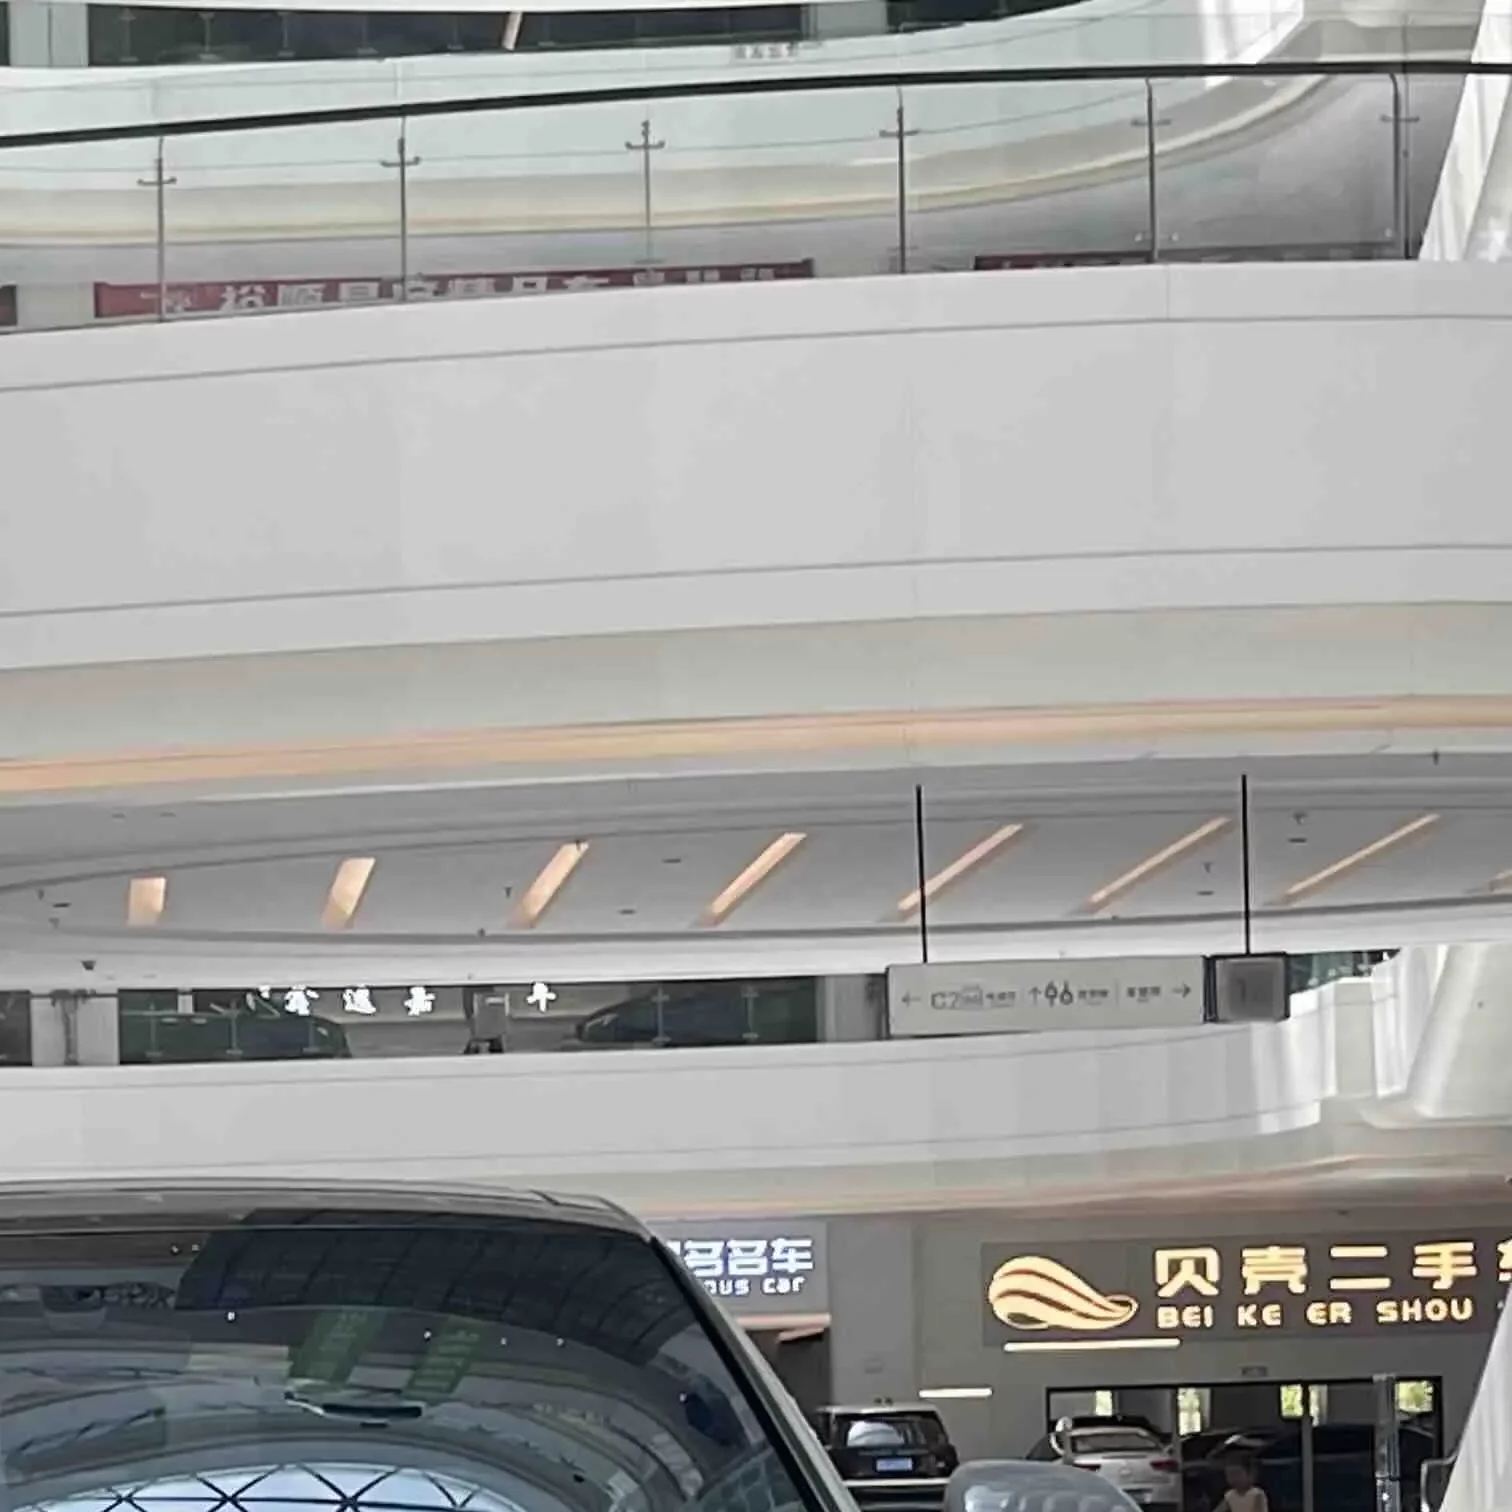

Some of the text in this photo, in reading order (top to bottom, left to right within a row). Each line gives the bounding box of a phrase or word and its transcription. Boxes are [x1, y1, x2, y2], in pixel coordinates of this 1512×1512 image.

[1156, 1297, 1473, 1328] BEI KE ER SHOU
